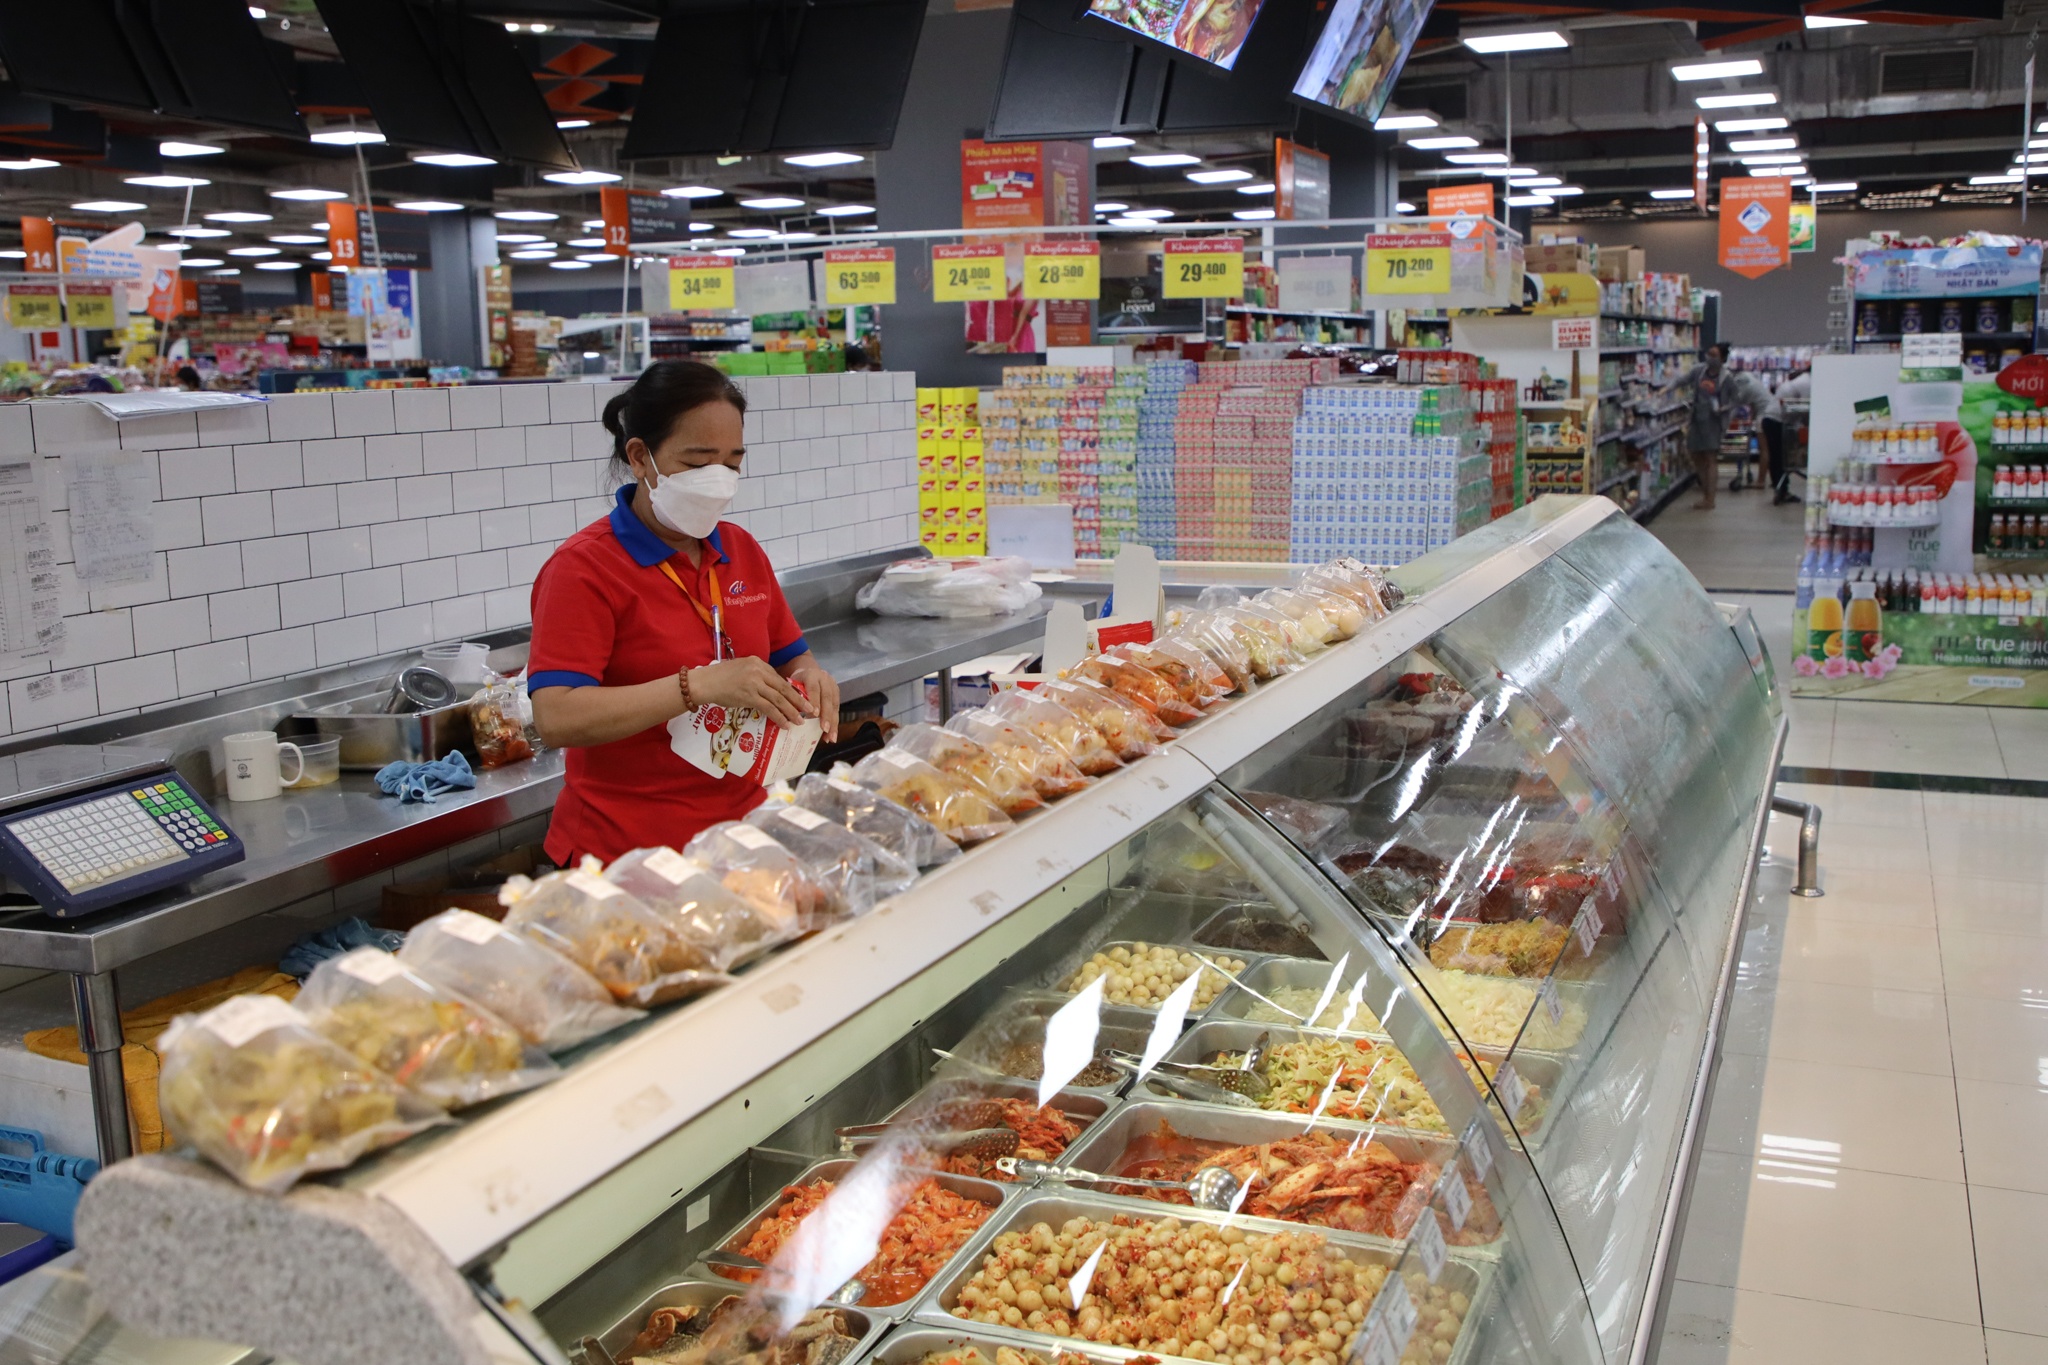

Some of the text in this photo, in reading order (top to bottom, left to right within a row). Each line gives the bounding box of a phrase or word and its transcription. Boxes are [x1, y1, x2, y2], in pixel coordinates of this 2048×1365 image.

[610, 226, 627, 245] 12
[336, 239, 354, 258] 13
[31, 251, 52, 269] 14
[1121, 302, 1155, 314] Legend
[2012, 373, 2045, 391] MỚI
[1908, 539, 1940, 551] true
[1976, 635, 2015, 652] true
[692, 702, 710, 731] OPHAT
